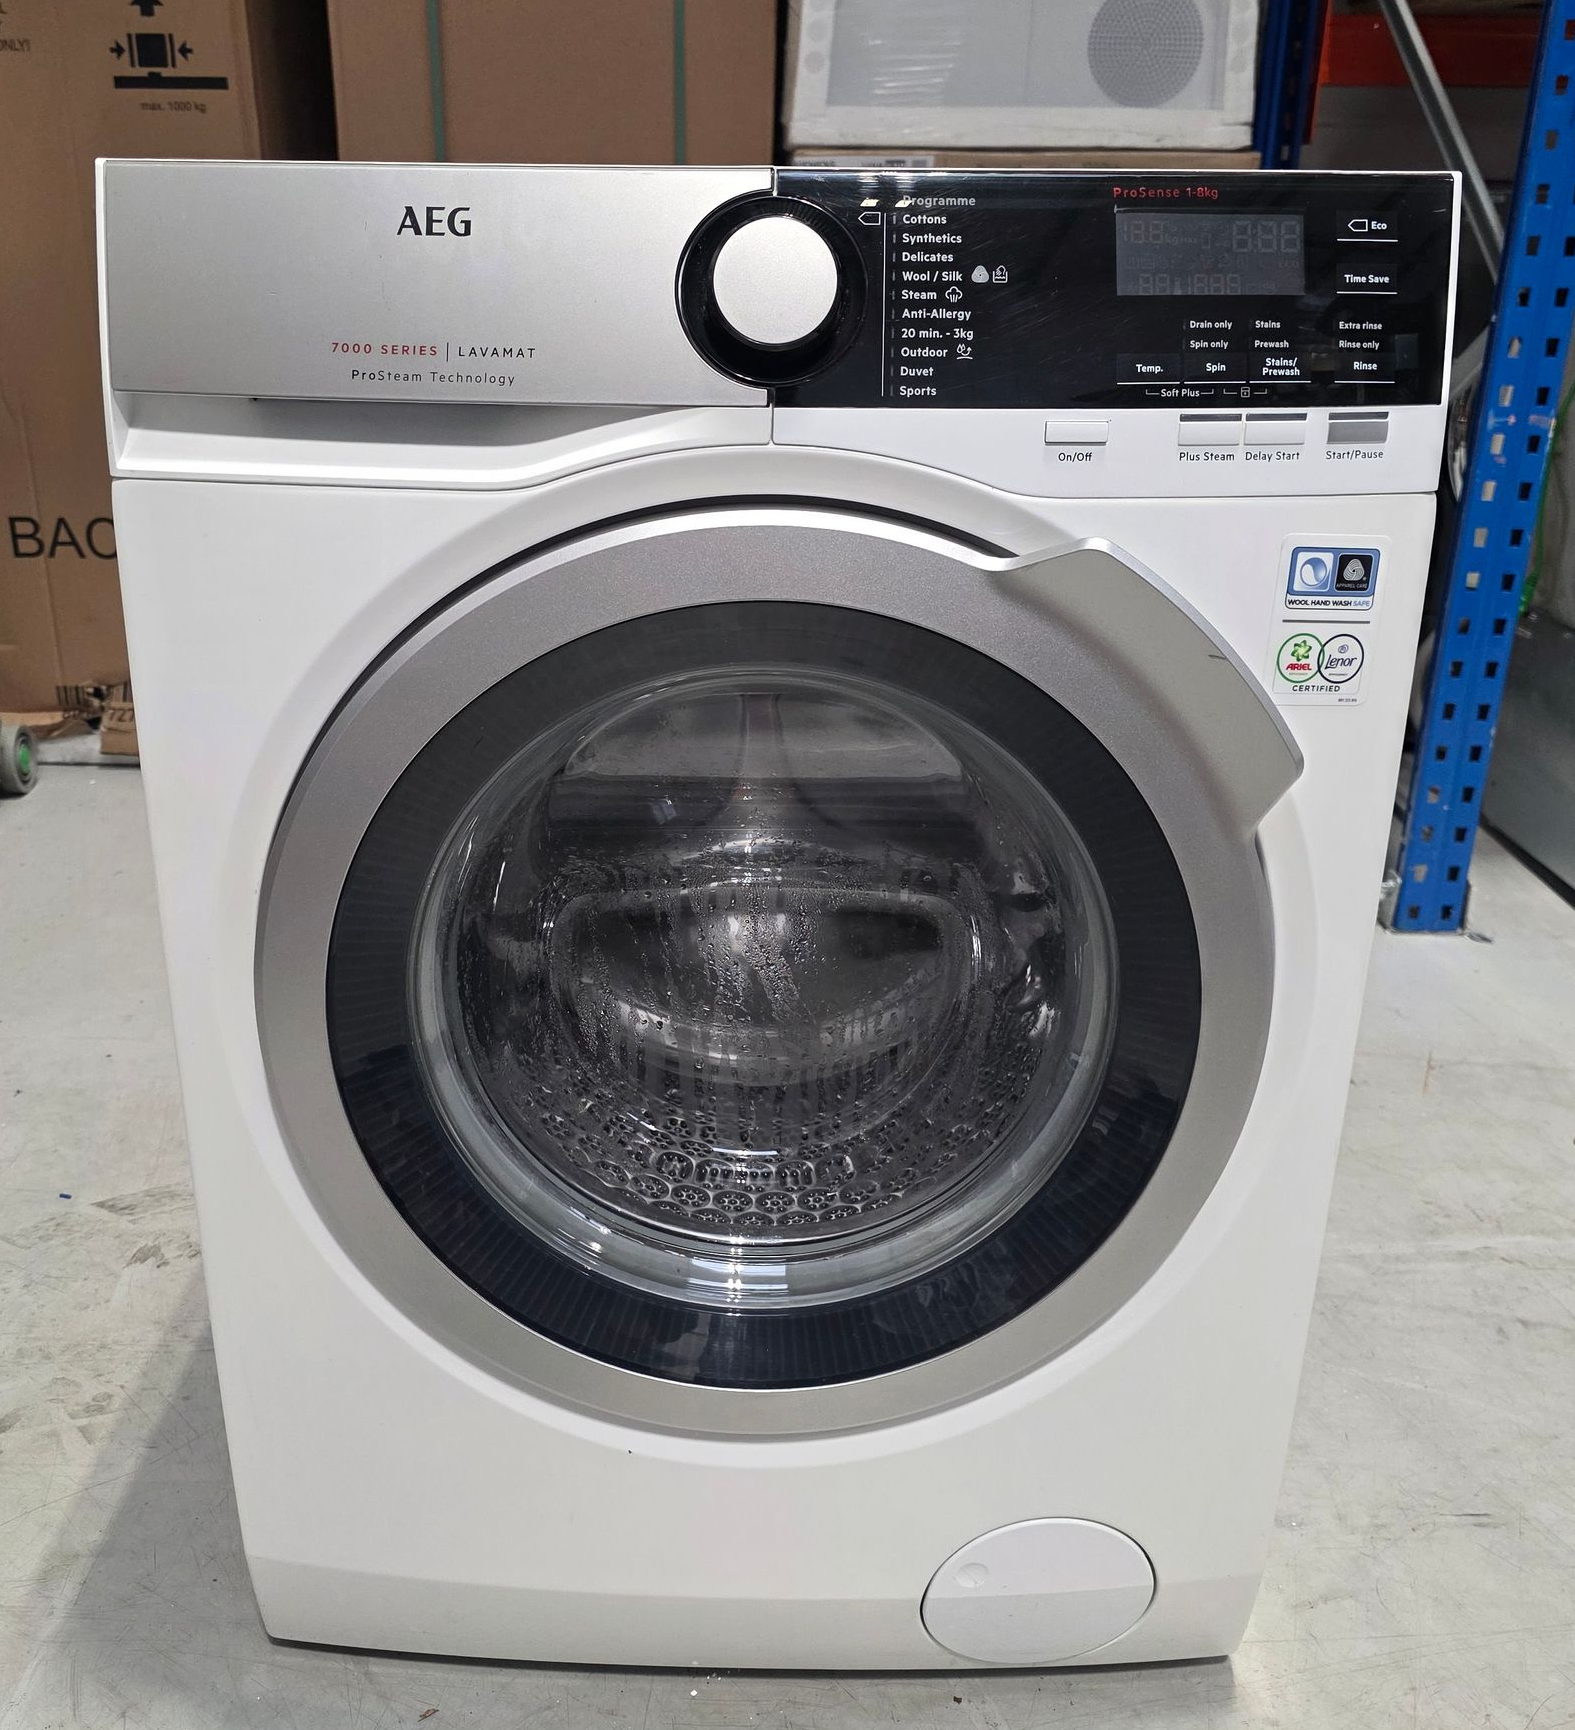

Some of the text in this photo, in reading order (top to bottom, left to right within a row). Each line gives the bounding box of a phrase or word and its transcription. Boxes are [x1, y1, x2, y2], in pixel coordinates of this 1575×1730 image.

[1113, 187, 1218, 200] ProSense 1-8kg
[903, 196, 976, 208] Programme
[396, 206, 472, 237] AEG
[903, 215, 946, 224] Cottons
[1372, 221, 1387, 229] Eco
[903, 233, 961, 245] Synthetics
[902, 252, 953, 261] Delicates
[902, 271, 930, 281] Wool
[942, 271, 962, 281] Silk
[1368, 275, 1389, 283] Save
[902, 290, 936, 299] Steam
[902, 309, 971, 320] Anti-Allergy
[1215, 320, 1232, 329] only
[1256, 320, 1280, 328] Stains
[902, 328, 915, 338] 20
[919, 328, 942, 338] min.
[954, 328, 973, 340] 3kg
[1190, 340, 1228, 349] Spin only
[1255, 340, 1289, 348] Prewash
[1339, 340, 1379, 350] Rinse only
[332, 343, 536, 358] 7000 SERIES LAVAMAT
[901, 347, 948, 357] Outdoor
[1265, 357, 1298, 367] Stains/
[1354, 362, 1377, 370] Rinse
[901, 366, 933, 376] Duvet
[1136, 364, 1163, 374] Temp.
[1206, 363, 1225, 373] Spin
[1263, 367, 1300, 375] Prewash
[351, 370, 515, 386] ProSteam Technology
[900, 386, 936, 397] Sports
[1161, 389, 1179, 397] Soft
[1058, 452, 1092, 462] On/Off
[1180, 452, 1234, 461] Plus Steam
[1246, 451, 1299, 462] Delay Start
[1326, 450, 1383, 460] Start/Pause
[1311, 599, 1331, 607] HAND
[1286, 663, 1312, 671] ARIEL
[1325, 654, 1358, 670] Lenor
